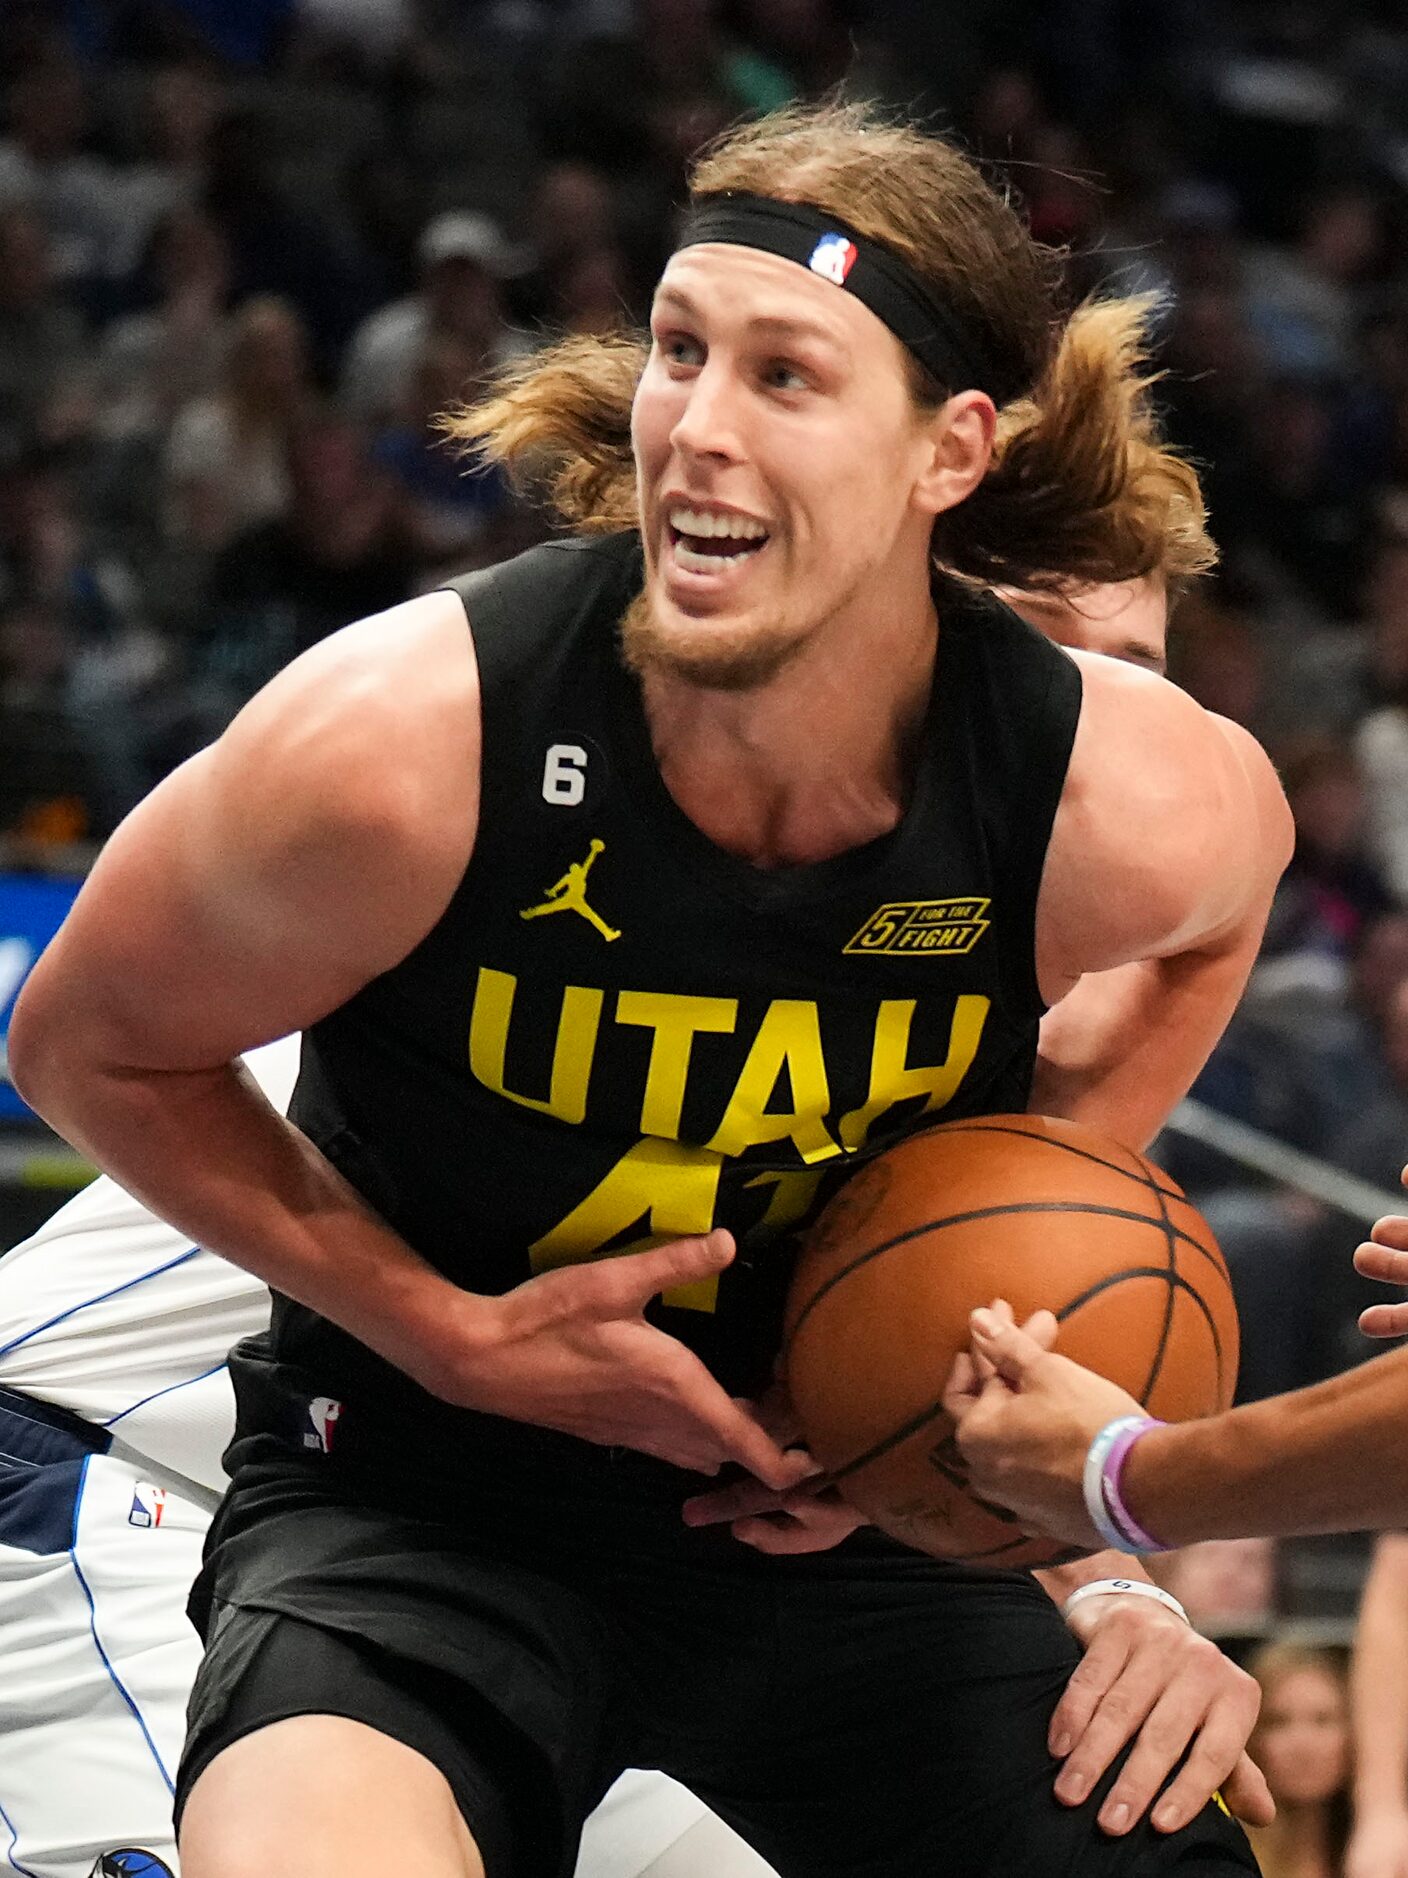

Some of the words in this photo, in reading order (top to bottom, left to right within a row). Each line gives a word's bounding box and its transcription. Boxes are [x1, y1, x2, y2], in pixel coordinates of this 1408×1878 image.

[542, 745, 587, 806] 6
[861, 910, 906, 947] 5
[919, 907, 947, 920] FOR
[898, 927, 975, 948] FIGHT
[469, 967, 991, 1164] UTAH
